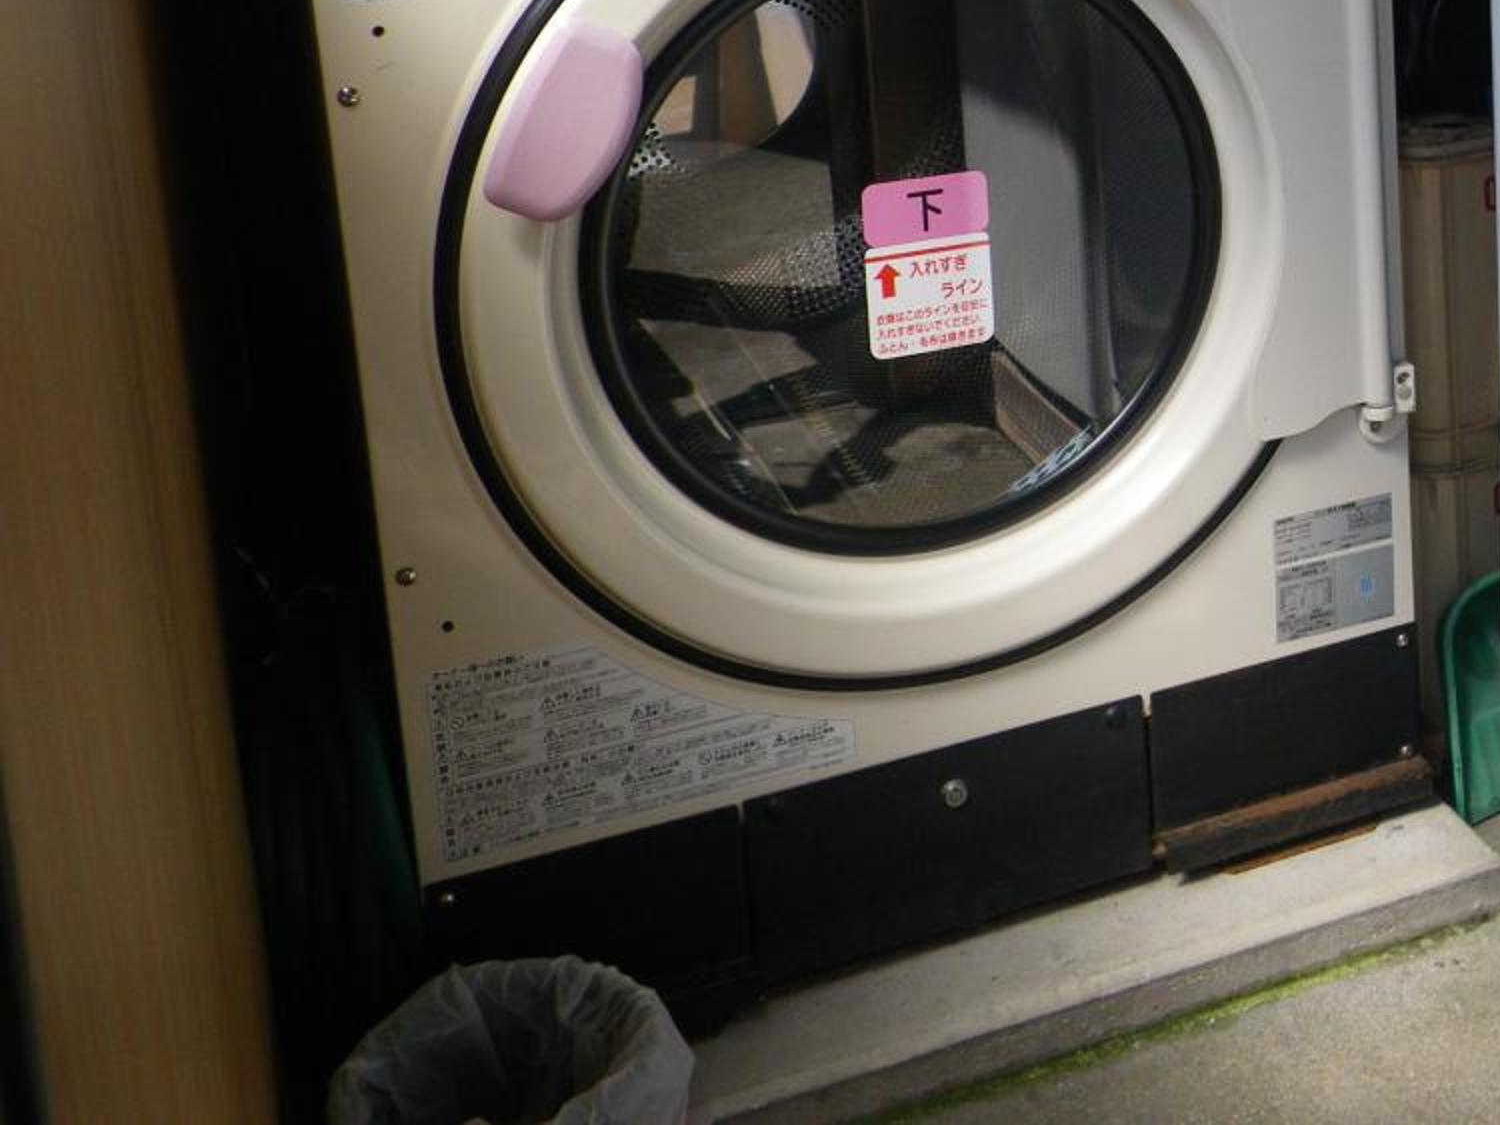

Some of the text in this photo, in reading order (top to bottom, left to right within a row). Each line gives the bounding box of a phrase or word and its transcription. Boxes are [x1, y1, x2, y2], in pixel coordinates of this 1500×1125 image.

[906, 188, 943, 233] 下
[911, 254, 967, 278] 入れすぎ
[941, 278, 983, 299] ライン
